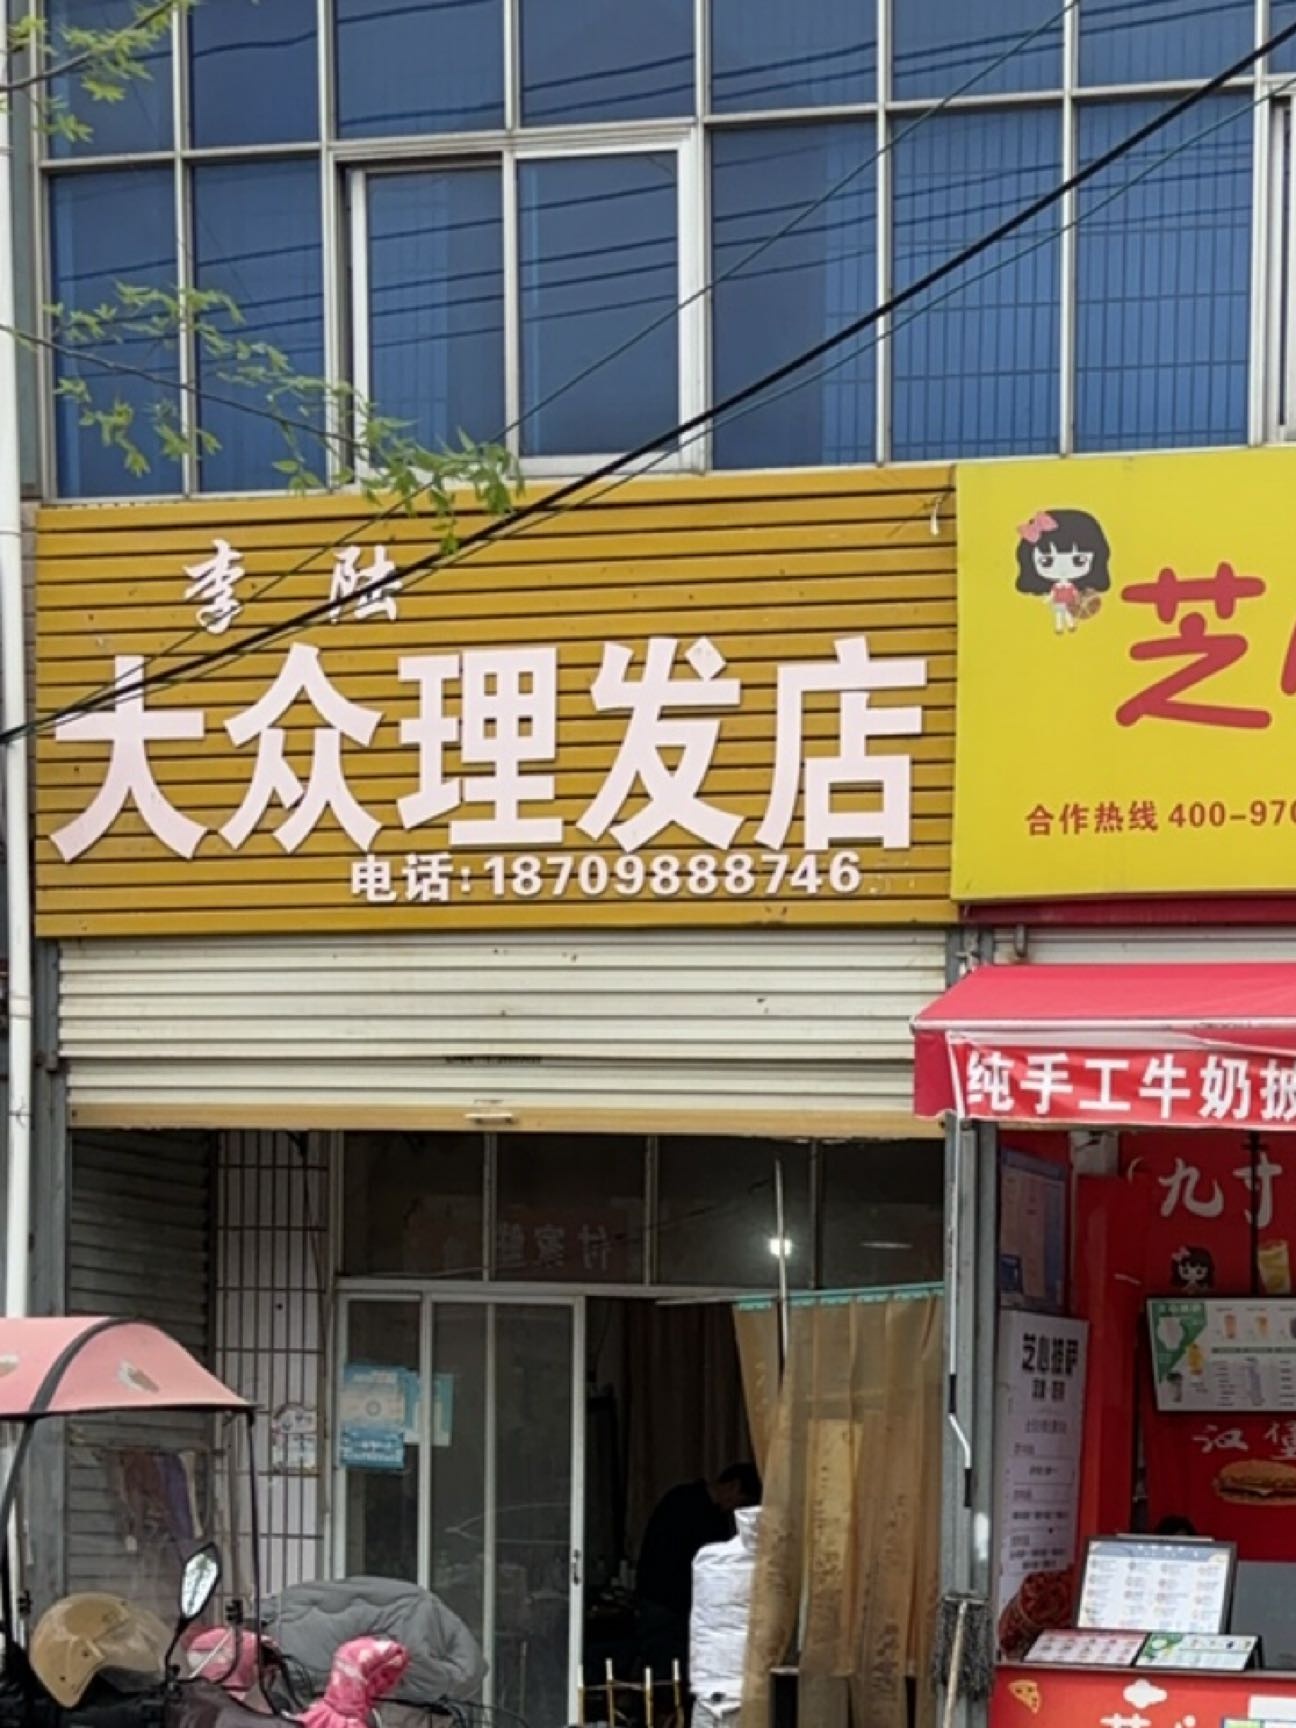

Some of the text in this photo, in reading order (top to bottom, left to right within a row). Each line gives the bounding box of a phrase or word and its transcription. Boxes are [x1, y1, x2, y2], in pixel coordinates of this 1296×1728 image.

[49, 636, 929, 864] 大众理发店
[1024, 798, 1160, 836] 合作热线
